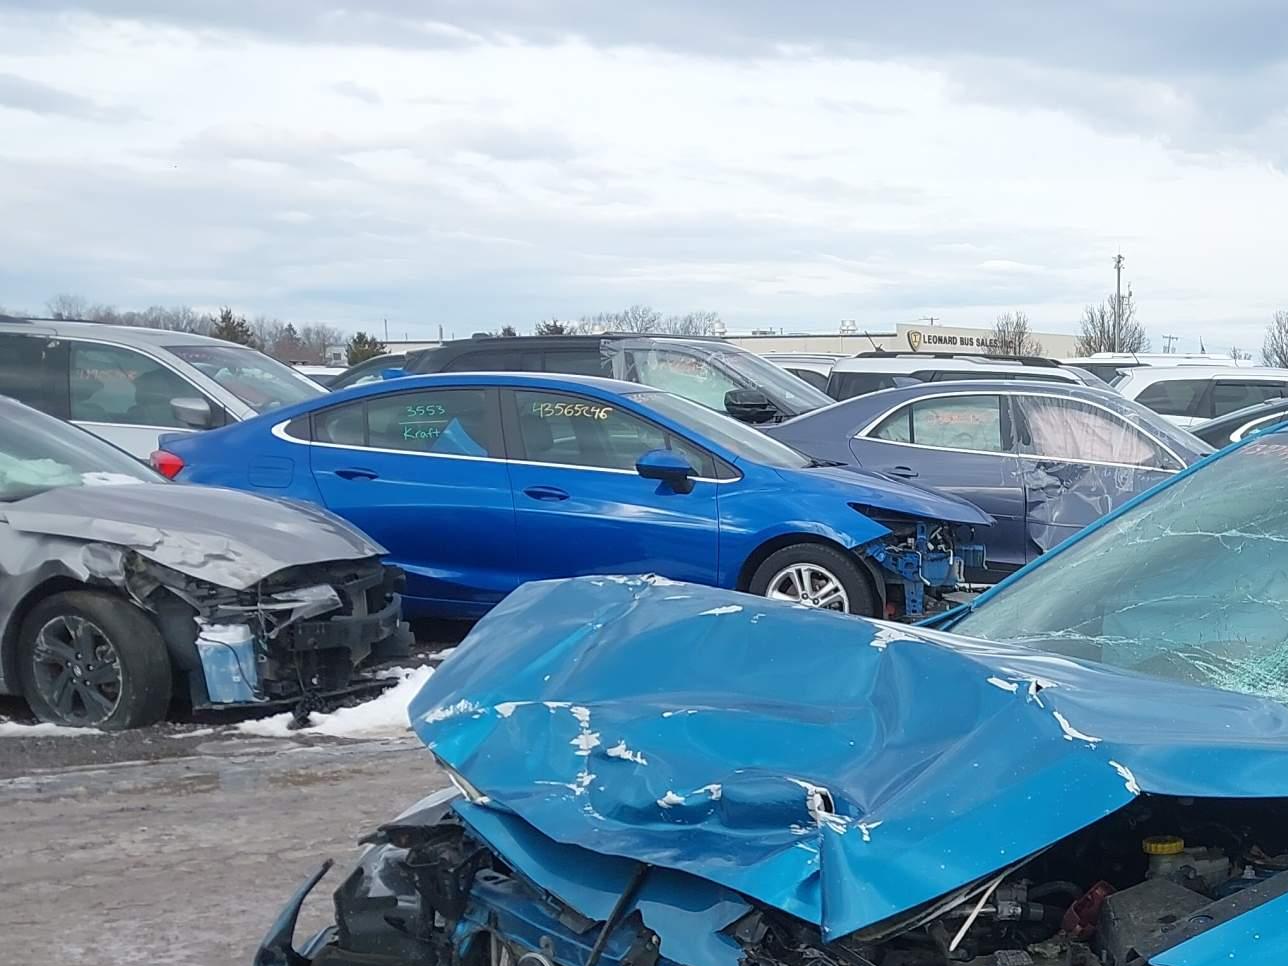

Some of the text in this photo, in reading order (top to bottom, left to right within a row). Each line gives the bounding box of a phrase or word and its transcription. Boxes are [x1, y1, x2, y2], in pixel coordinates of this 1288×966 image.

[923, 335, 957, 346] LEONARD
[960, 337, 974, 346] BUS
[406, 404, 446, 417] 3553
[403, 425, 441, 440] Kraft
